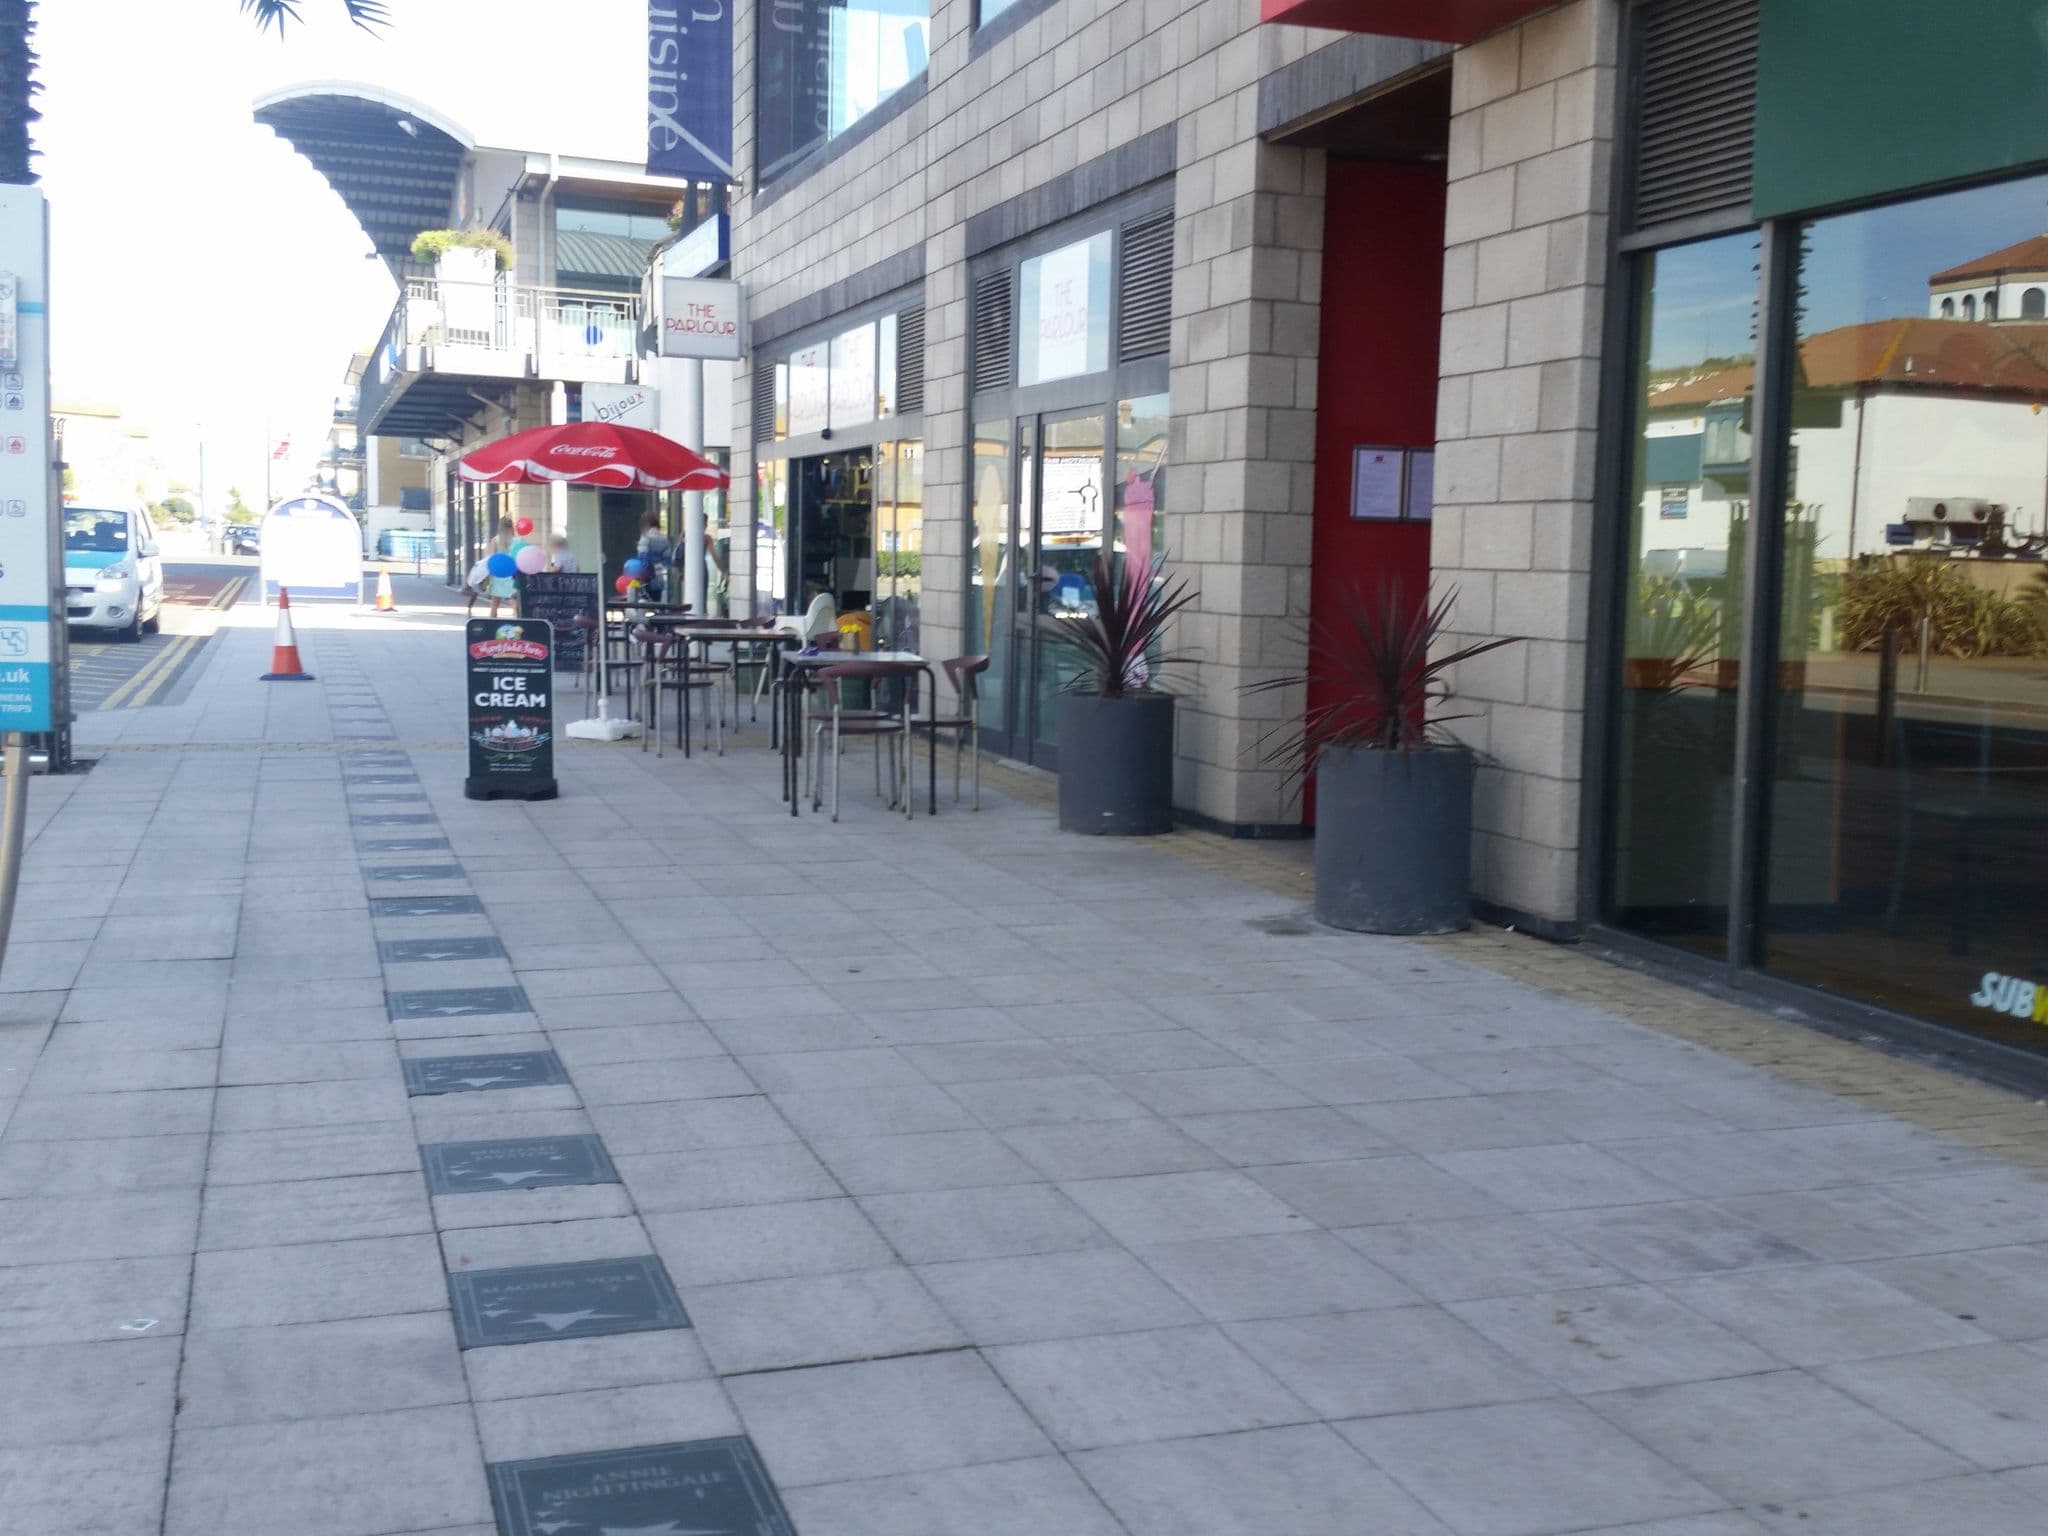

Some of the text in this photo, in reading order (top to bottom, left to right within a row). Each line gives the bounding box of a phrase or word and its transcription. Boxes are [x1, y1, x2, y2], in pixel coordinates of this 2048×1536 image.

[687, 303, 715, 318] THE
[665, 317, 736, 335] PARLOUR
[591, 390, 644, 421] bijoux
[493, 676, 528, 692] ICE
[474, 693, 547, 708] CREAM
